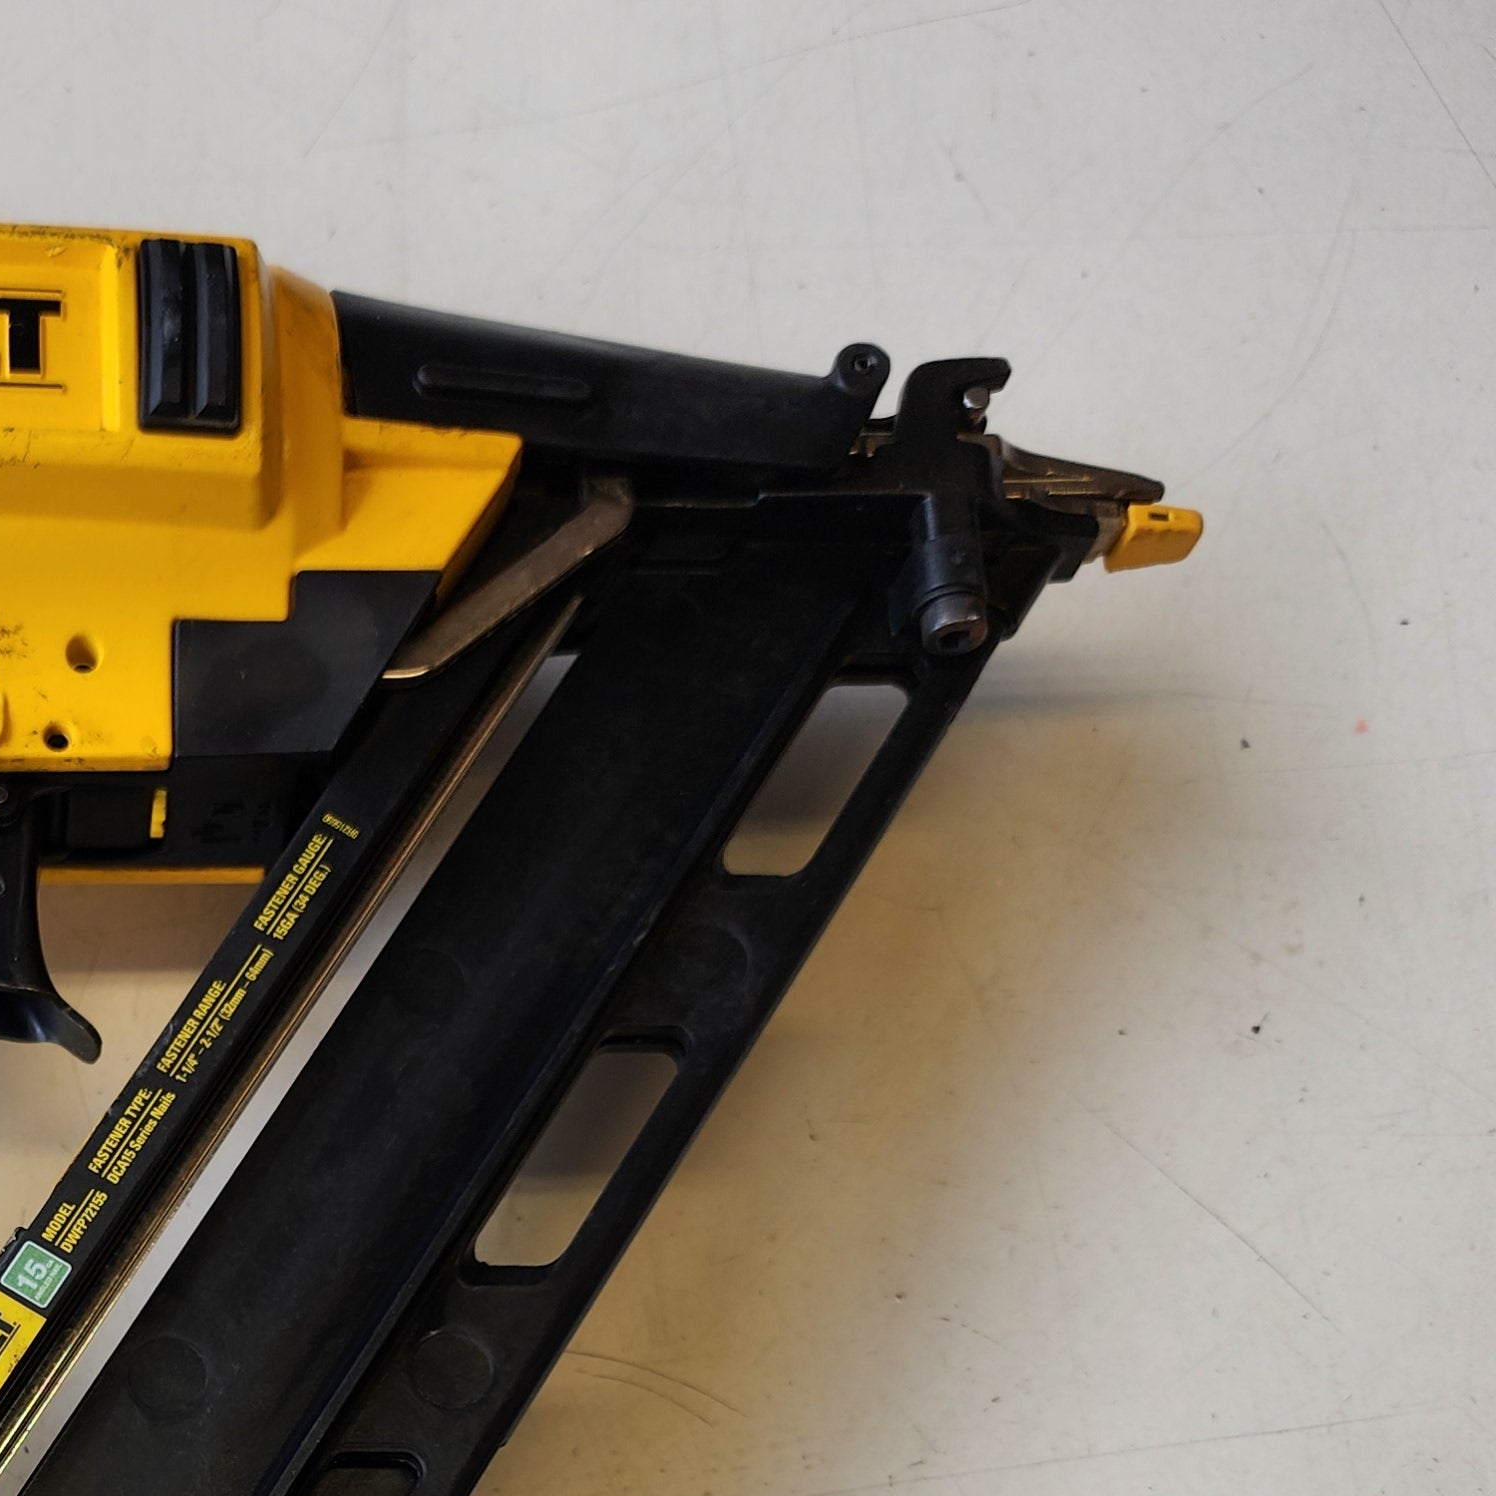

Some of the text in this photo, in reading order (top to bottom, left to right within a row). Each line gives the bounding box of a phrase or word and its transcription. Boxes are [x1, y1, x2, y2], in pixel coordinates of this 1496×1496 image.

[253, 834, 328, 931] FASTENER GAUGE:
[272, 864, 332, 940] 15GA (34 DEG.)
[218, 988, 247, 1020] (32mm
[245, 948, 274, 981] 64mm)
[156, 980, 227, 1073] FASTENER RANGE:
[88, 1087, 153, 1174] FASTENER TYPE:
[106, 1091, 176, 1184] DCA15 Series Nails
[41, 1202, 76, 1242] MODEL
[60, 1190, 108, 1253] DWFP72155
